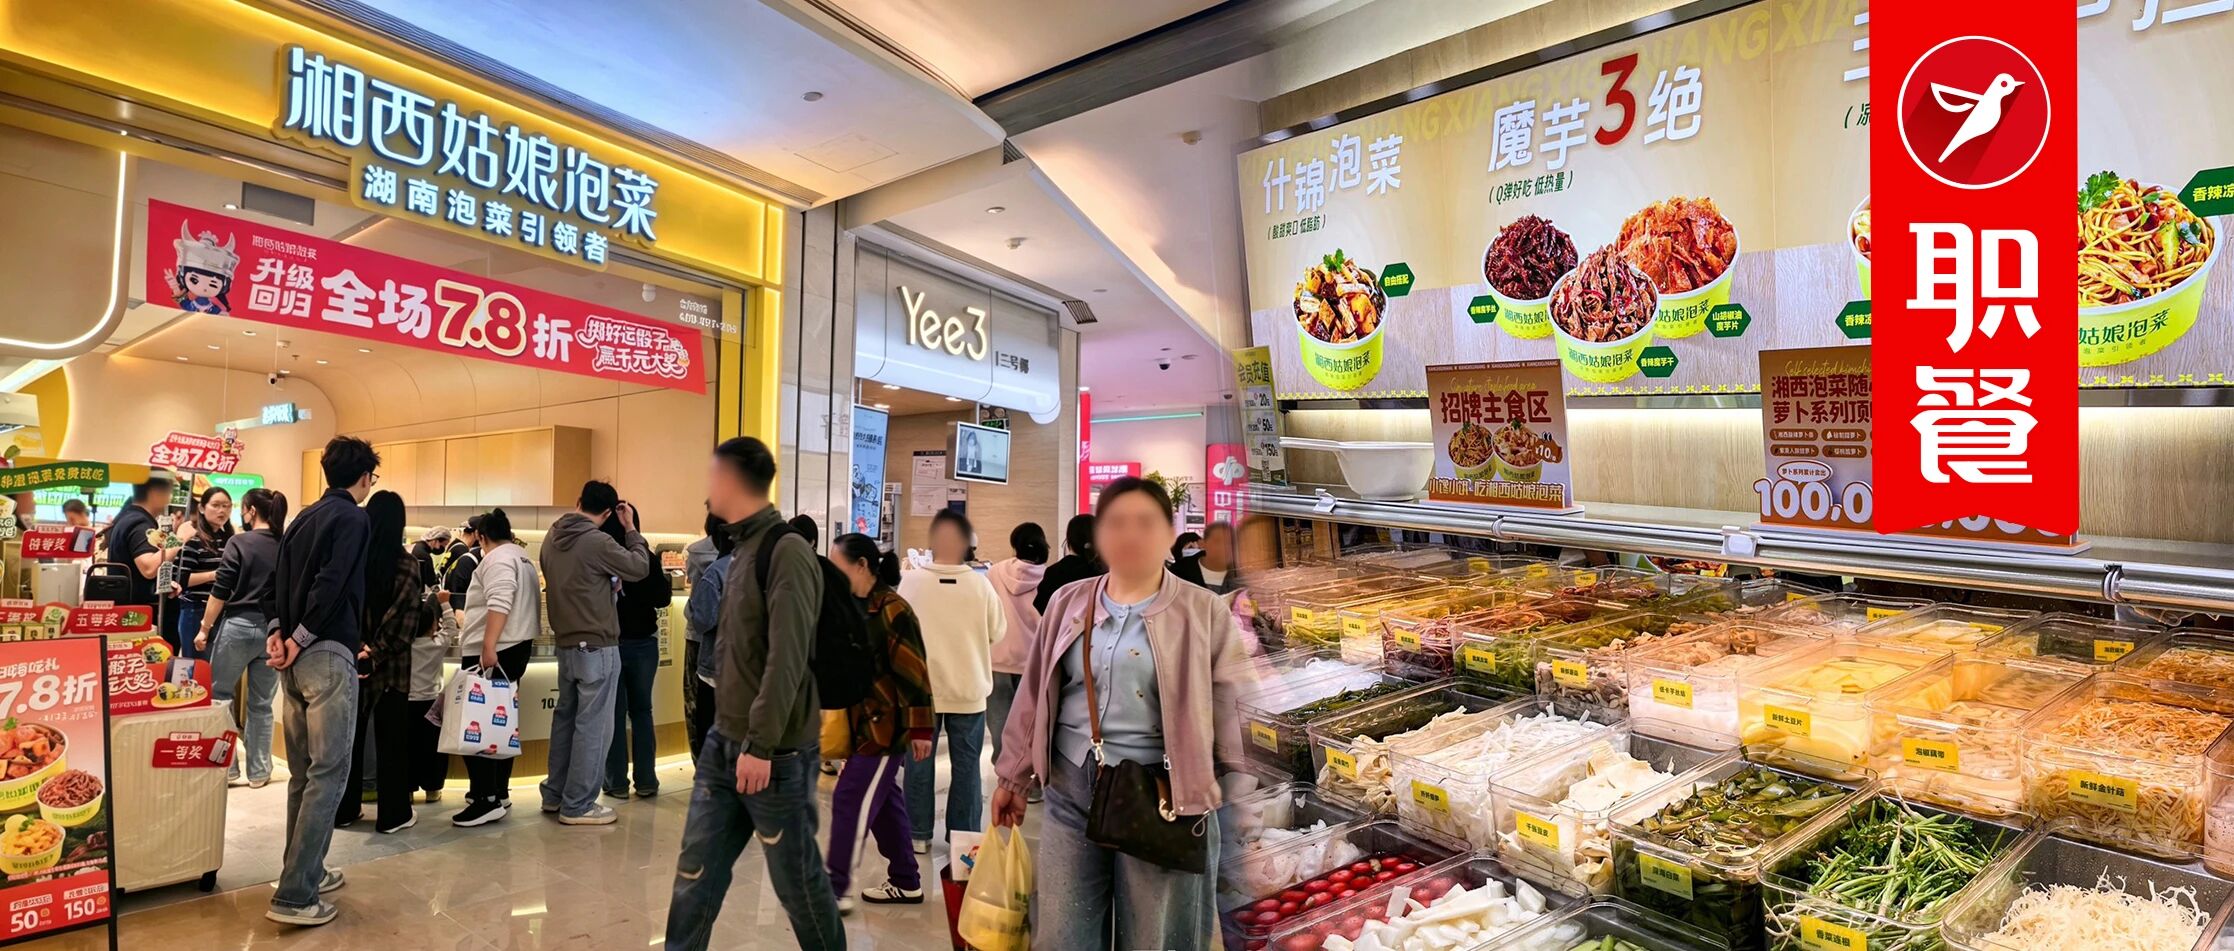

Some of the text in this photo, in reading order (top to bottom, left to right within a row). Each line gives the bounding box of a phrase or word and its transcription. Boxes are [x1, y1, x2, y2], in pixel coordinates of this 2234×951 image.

[1488, 53, 1704, 173] 魔芋3绝
[285, 47, 659, 240] 湘西姑娘泡菜
[1263, 133, 1404, 215] 什锦泡菜
[363, 163, 608, 265] 湖南泡菜引领者
[249, 258, 315, 292] 升级
[247, 283, 312, 318] 回归
[1504, 308, 1549, 325] 湘西姑娘
[898, 285, 988, 361] Yee3
[1771, 373, 1872, 399] 湘西泡菜随
[1440, 389, 1552, 425] 招牌主食区
[1772, 400, 1872, 424] 萝卜系列顶
[160, 745, 203, 760] 一等奖
[2080, 780, 2125, 798] 新鲜金针菇
[11, 910, 39, 933] 50
[63, 898, 96, 920] 150
